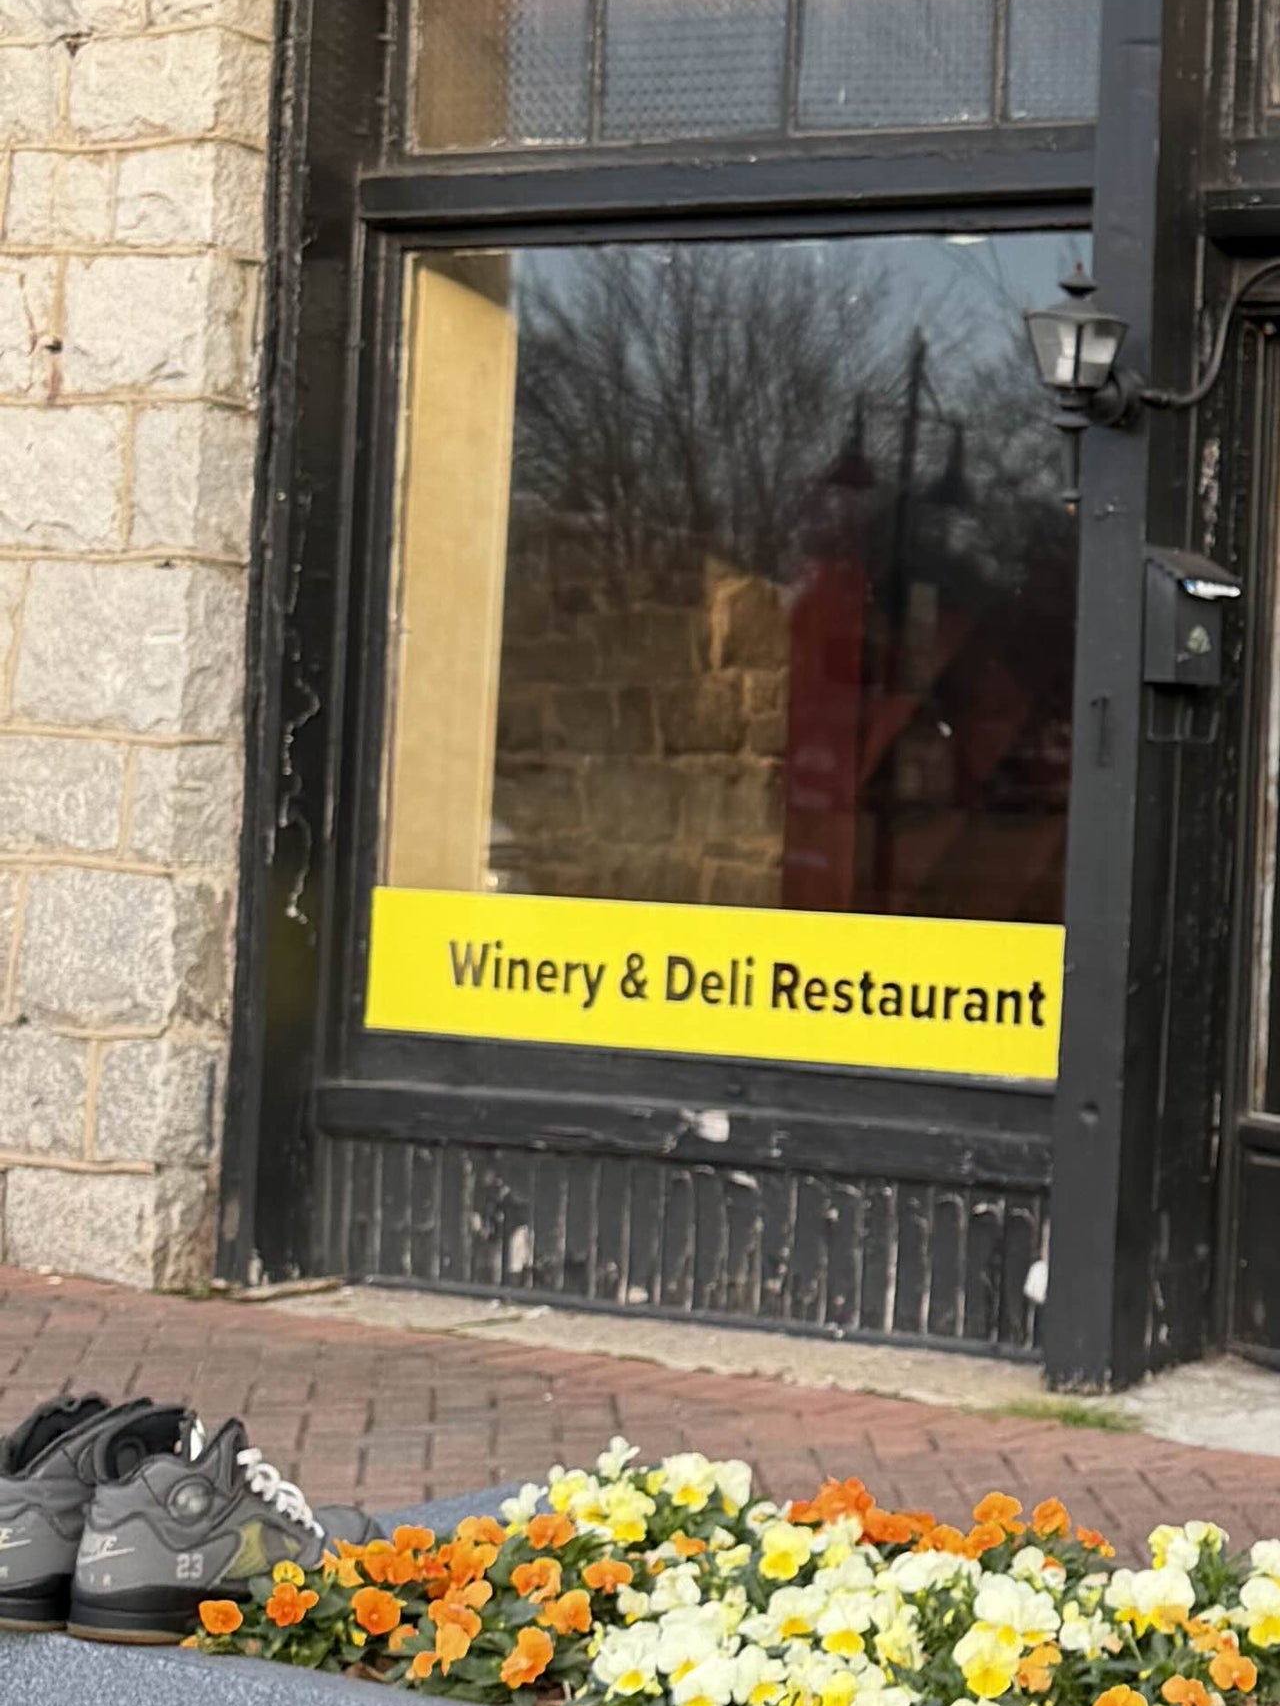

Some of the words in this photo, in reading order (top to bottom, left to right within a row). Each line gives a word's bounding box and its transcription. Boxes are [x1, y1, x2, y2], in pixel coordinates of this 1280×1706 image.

[449, 939, 606, 1009] Winery
[619, 953, 648, 1001] &
[665, 955, 753, 1007] Deli
[771, 962, 1046, 1028] Restaurant
[176, 1553, 204, 1580] 23
